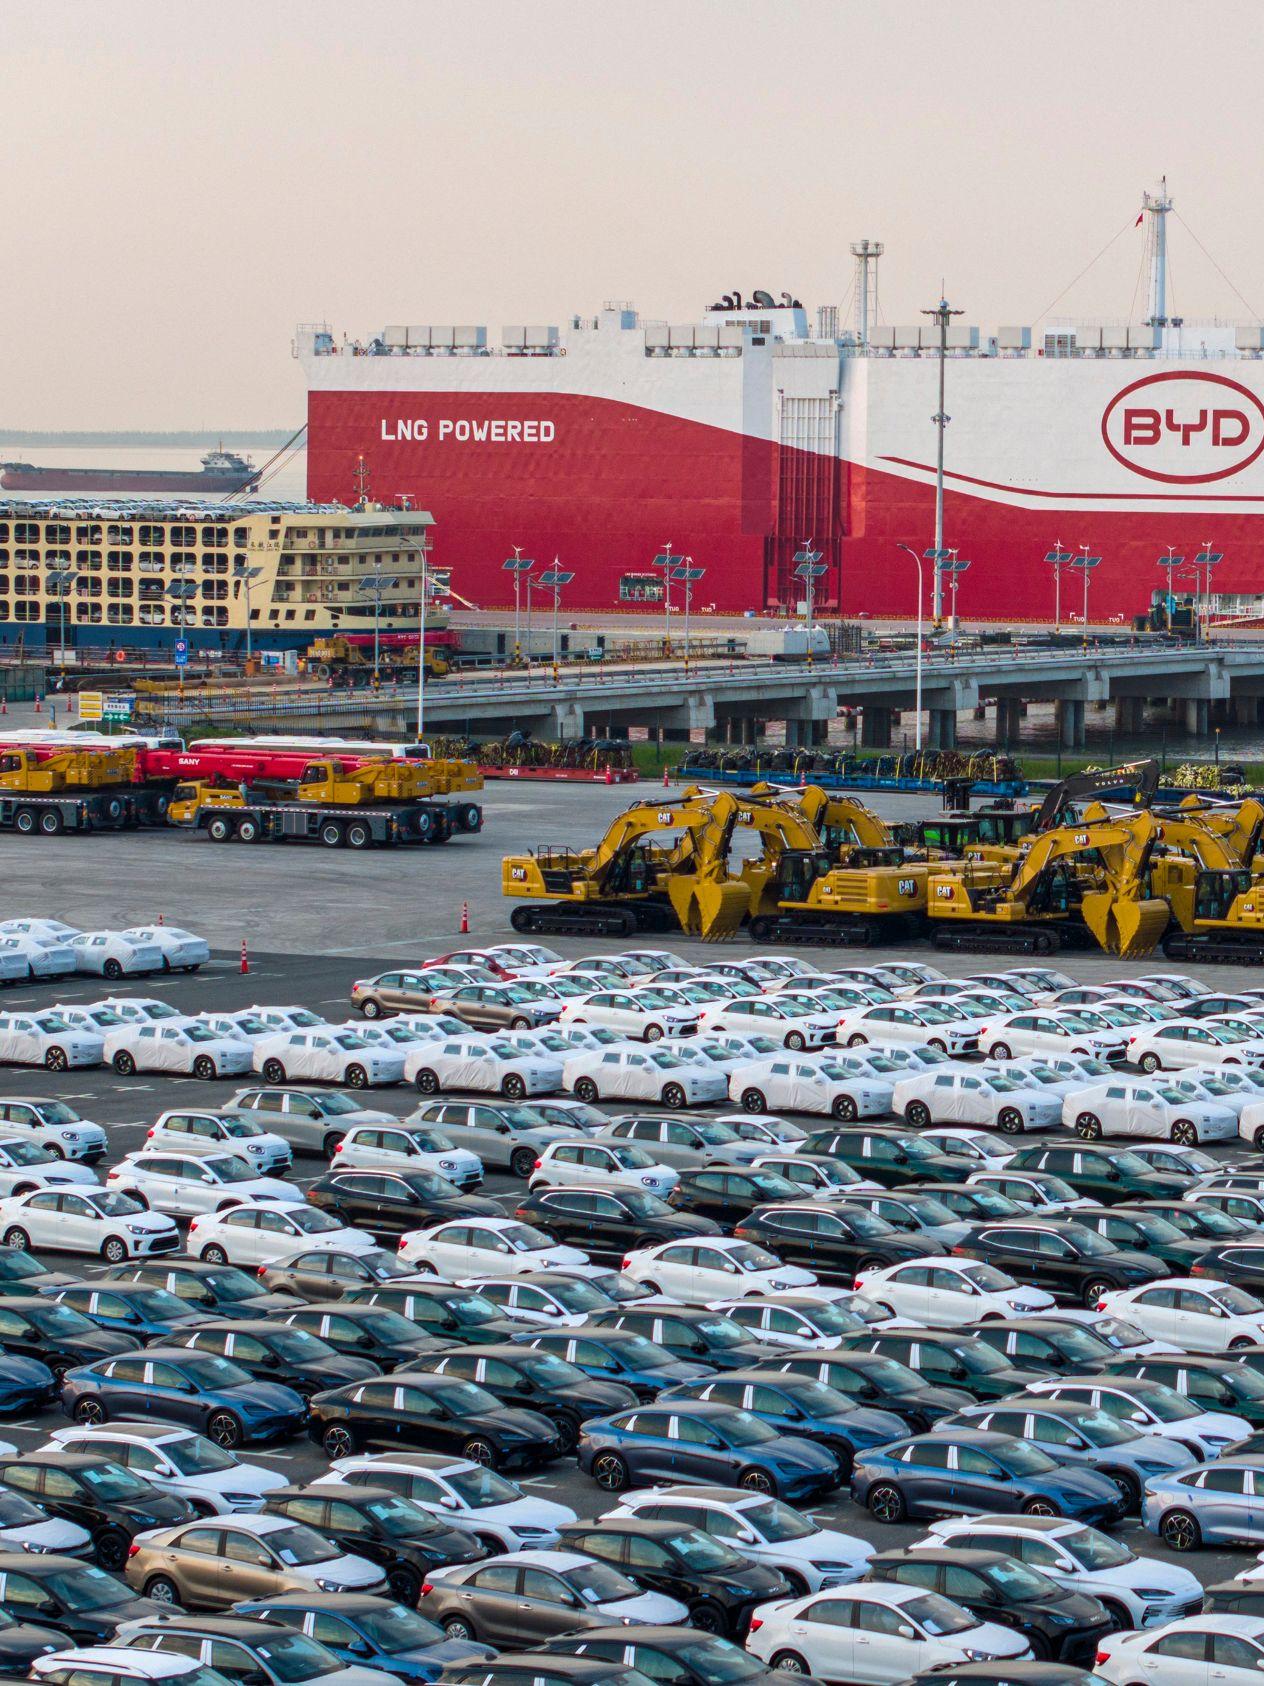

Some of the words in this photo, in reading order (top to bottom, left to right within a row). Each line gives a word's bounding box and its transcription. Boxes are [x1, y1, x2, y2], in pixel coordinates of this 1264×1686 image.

[381, 419, 429, 441] LNG
[439, 420, 556, 443] POWERED
[1123, 408, 1251, 447] BYD
[178, 757, 201, 766] SANY
[1095, 779, 1124, 787] VOLVO
[657, 811, 672, 825] CAT
[737, 811, 752, 823] CAT
[1073, 833, 1088, 845] CAT
[512, 868, 525, 880] CAT
[898, 879, 915, 896] CAT
[937, 885, 952, 898] CAT
